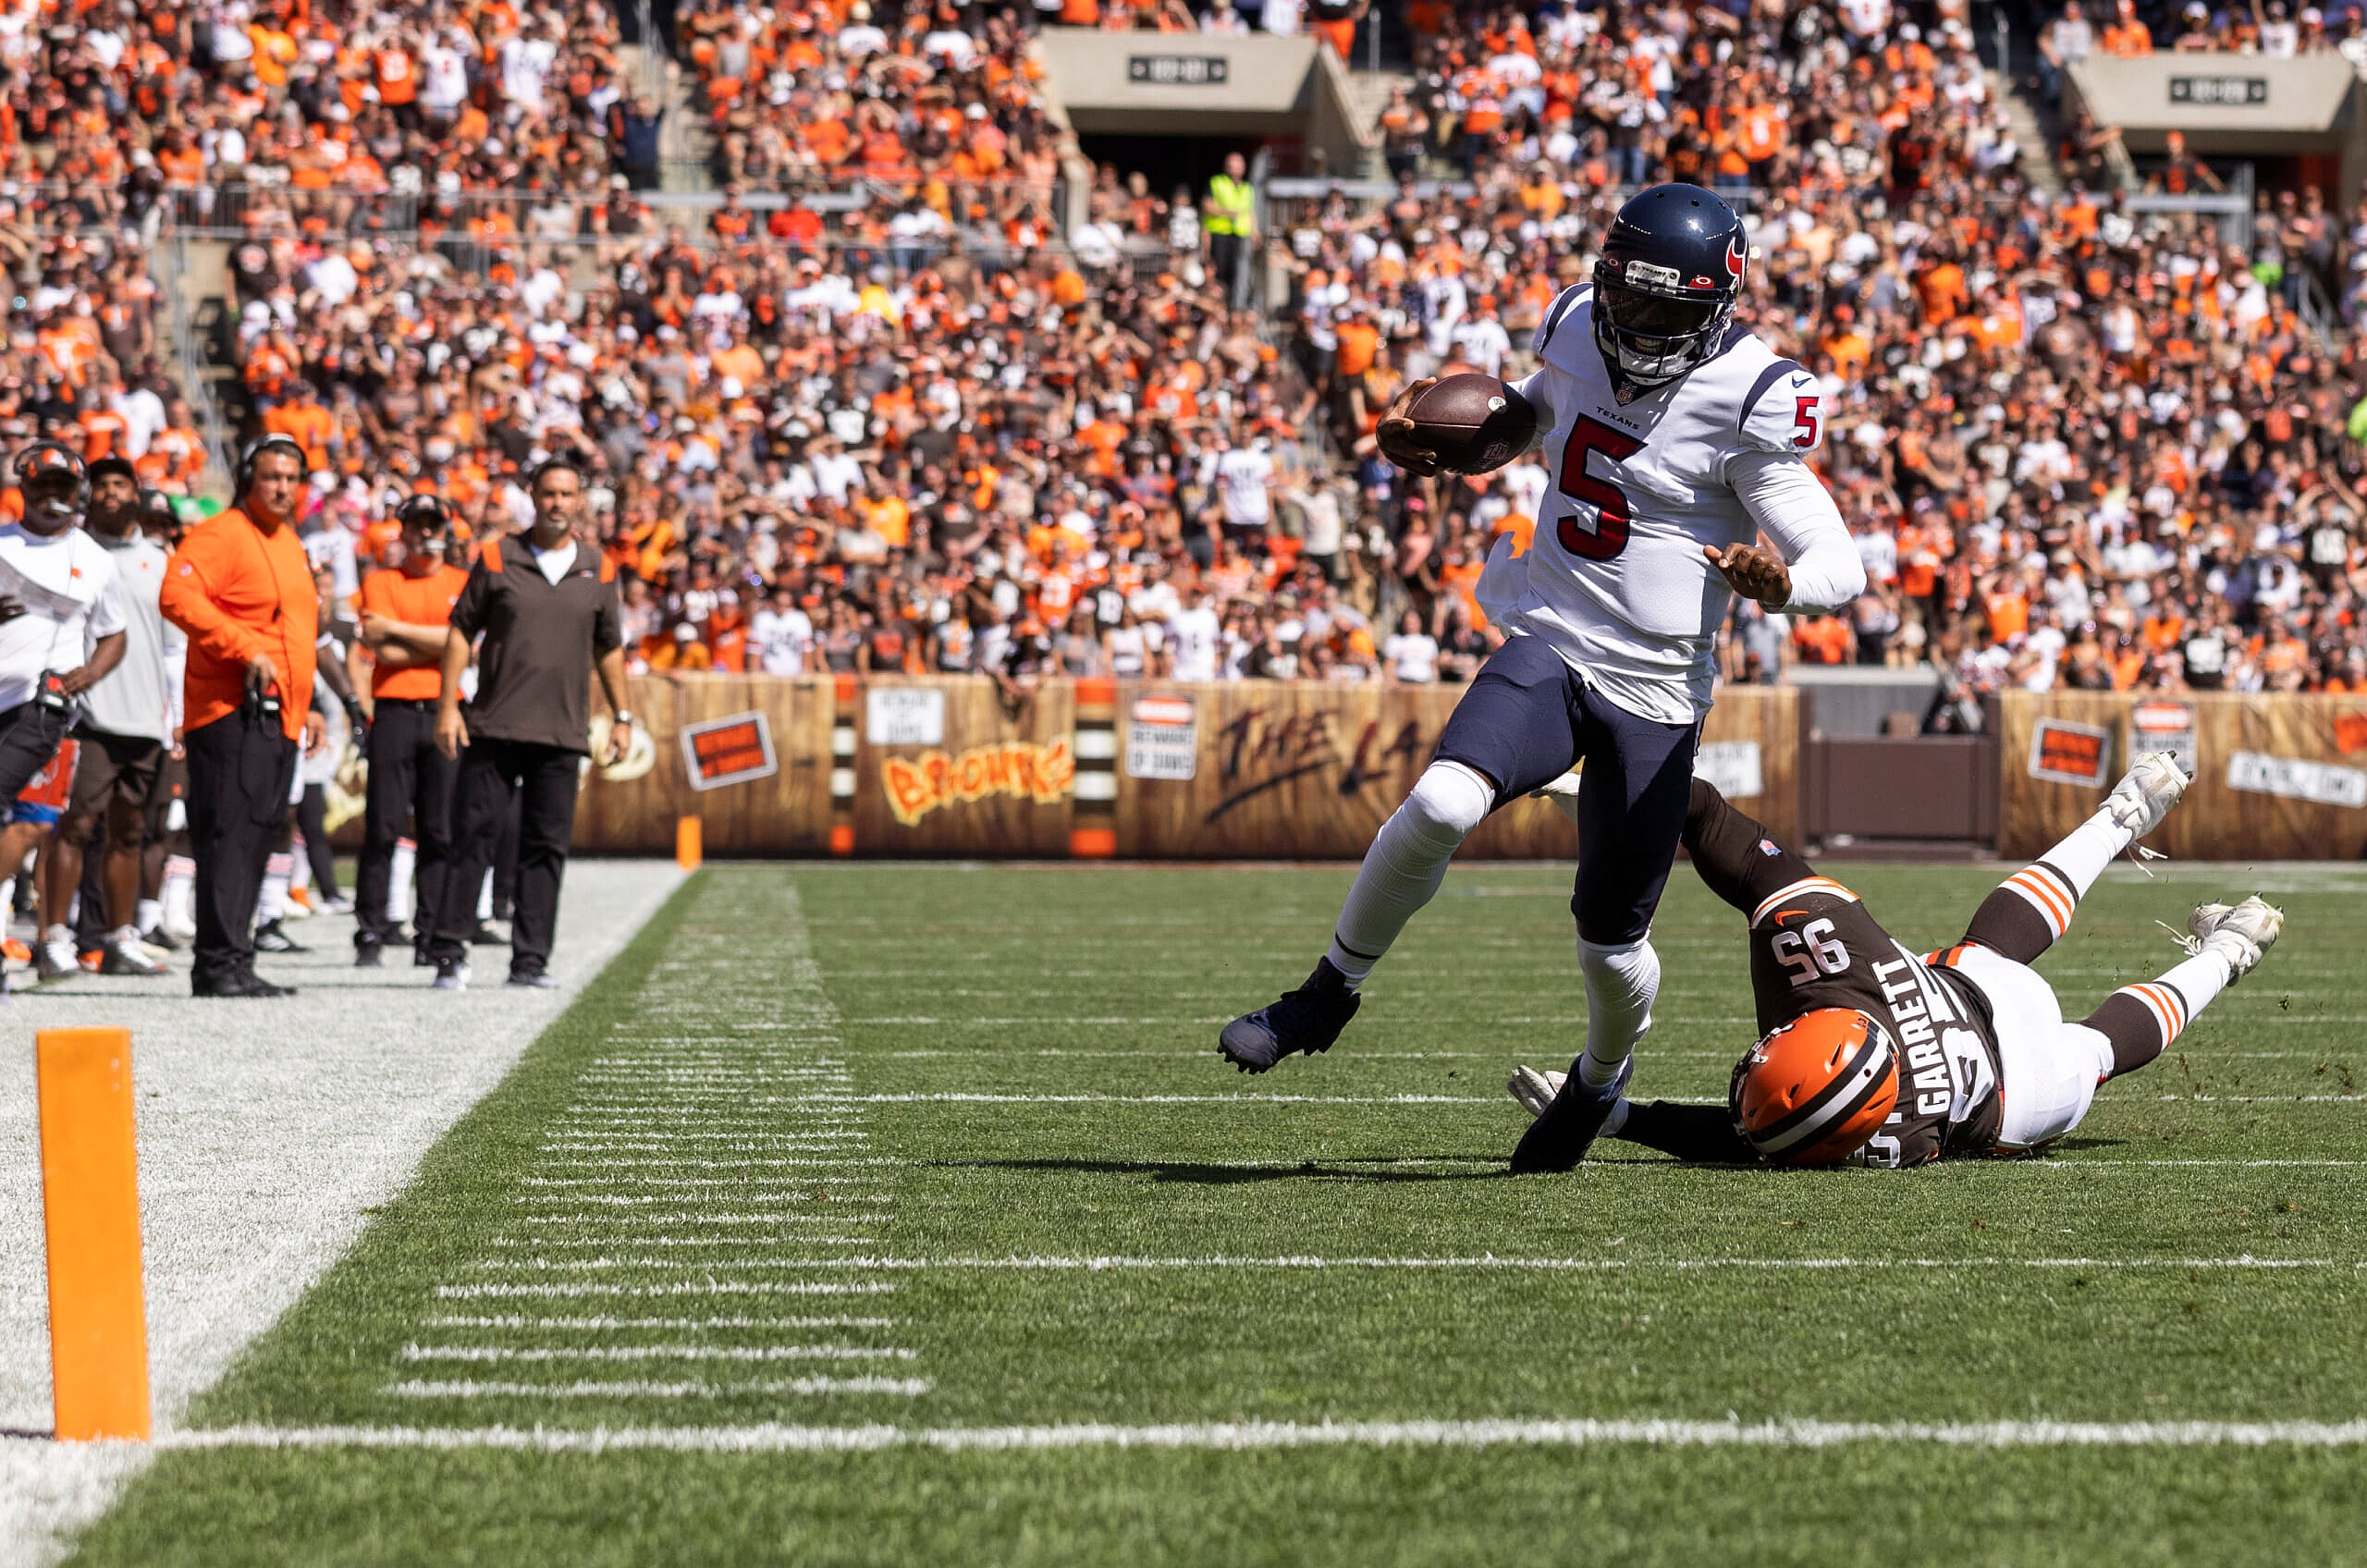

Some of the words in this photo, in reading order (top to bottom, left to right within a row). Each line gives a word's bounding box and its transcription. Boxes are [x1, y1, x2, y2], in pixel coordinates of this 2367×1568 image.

[1596, 406, 1640, 430] TEXANS
[1794, 396, 1820, 447] 5
[1556, 411, 1649, 563] 5
[1771, 917, 1850, 986] 95
[1871, 959, 1952, 1116] GARRETT
